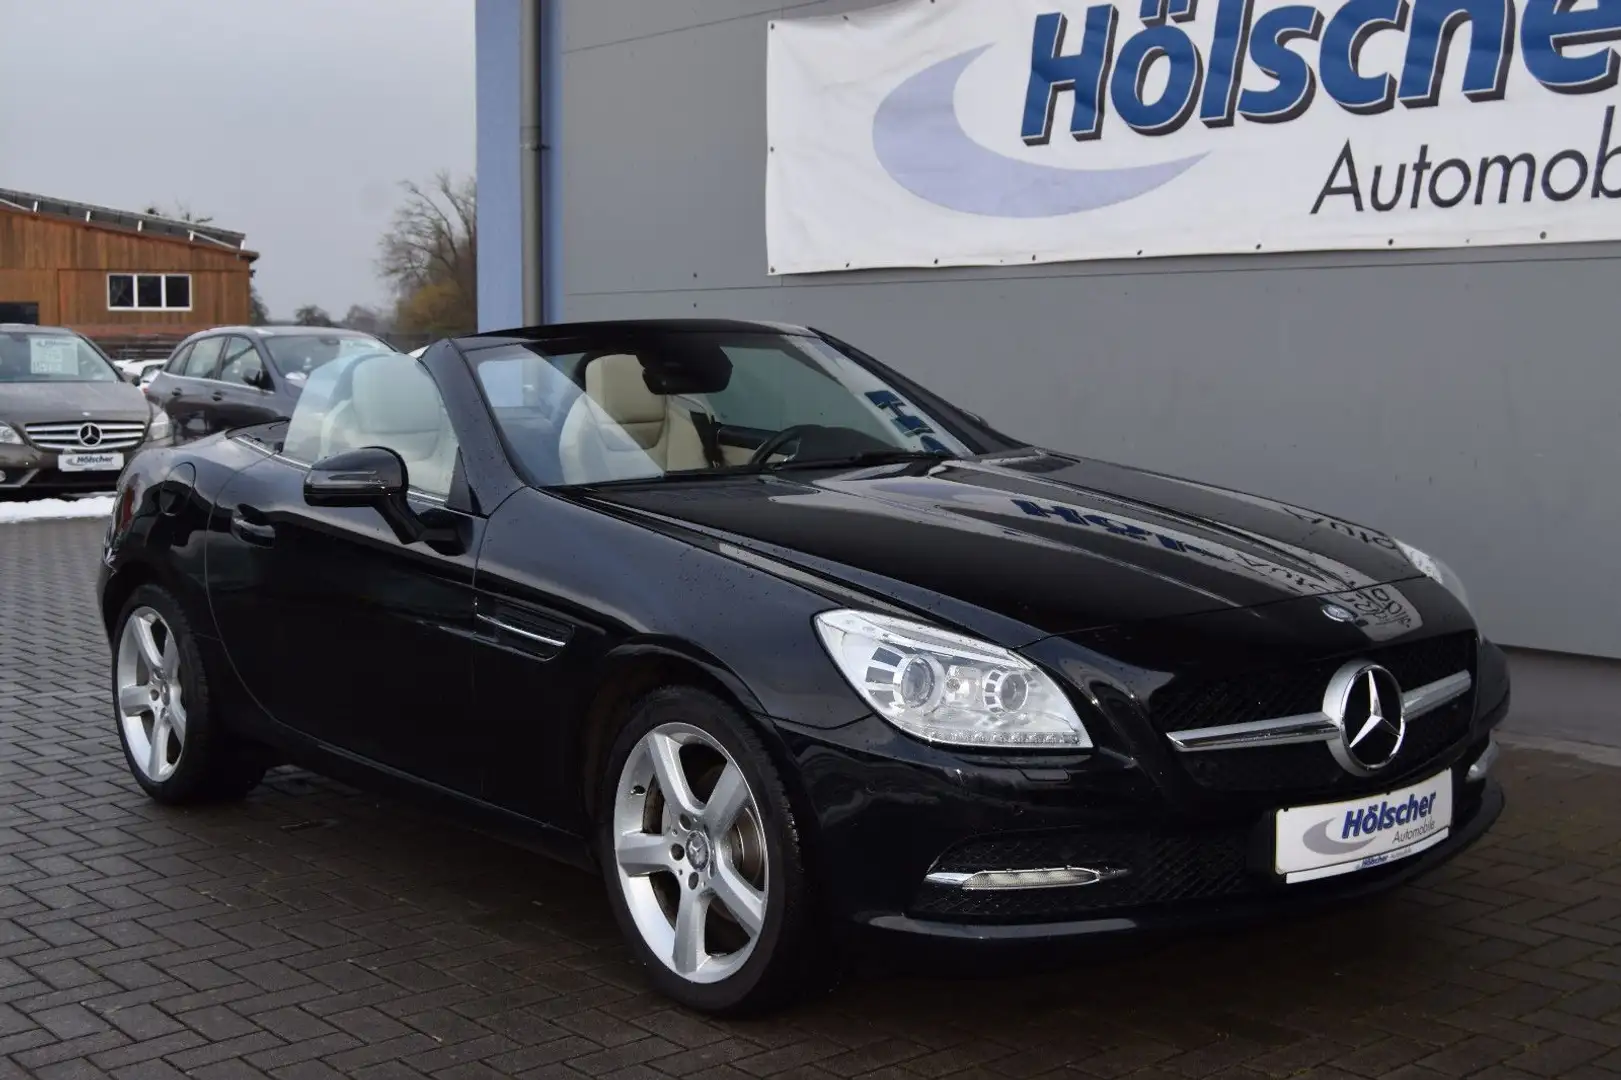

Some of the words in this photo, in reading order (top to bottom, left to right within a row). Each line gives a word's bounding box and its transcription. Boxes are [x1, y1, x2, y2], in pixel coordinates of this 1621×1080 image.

[1310, 105, 1621, 214] Automob
[1341, 790, 1437, 839] Hölscher
[1391, 818, 1436, 844] Automobile
